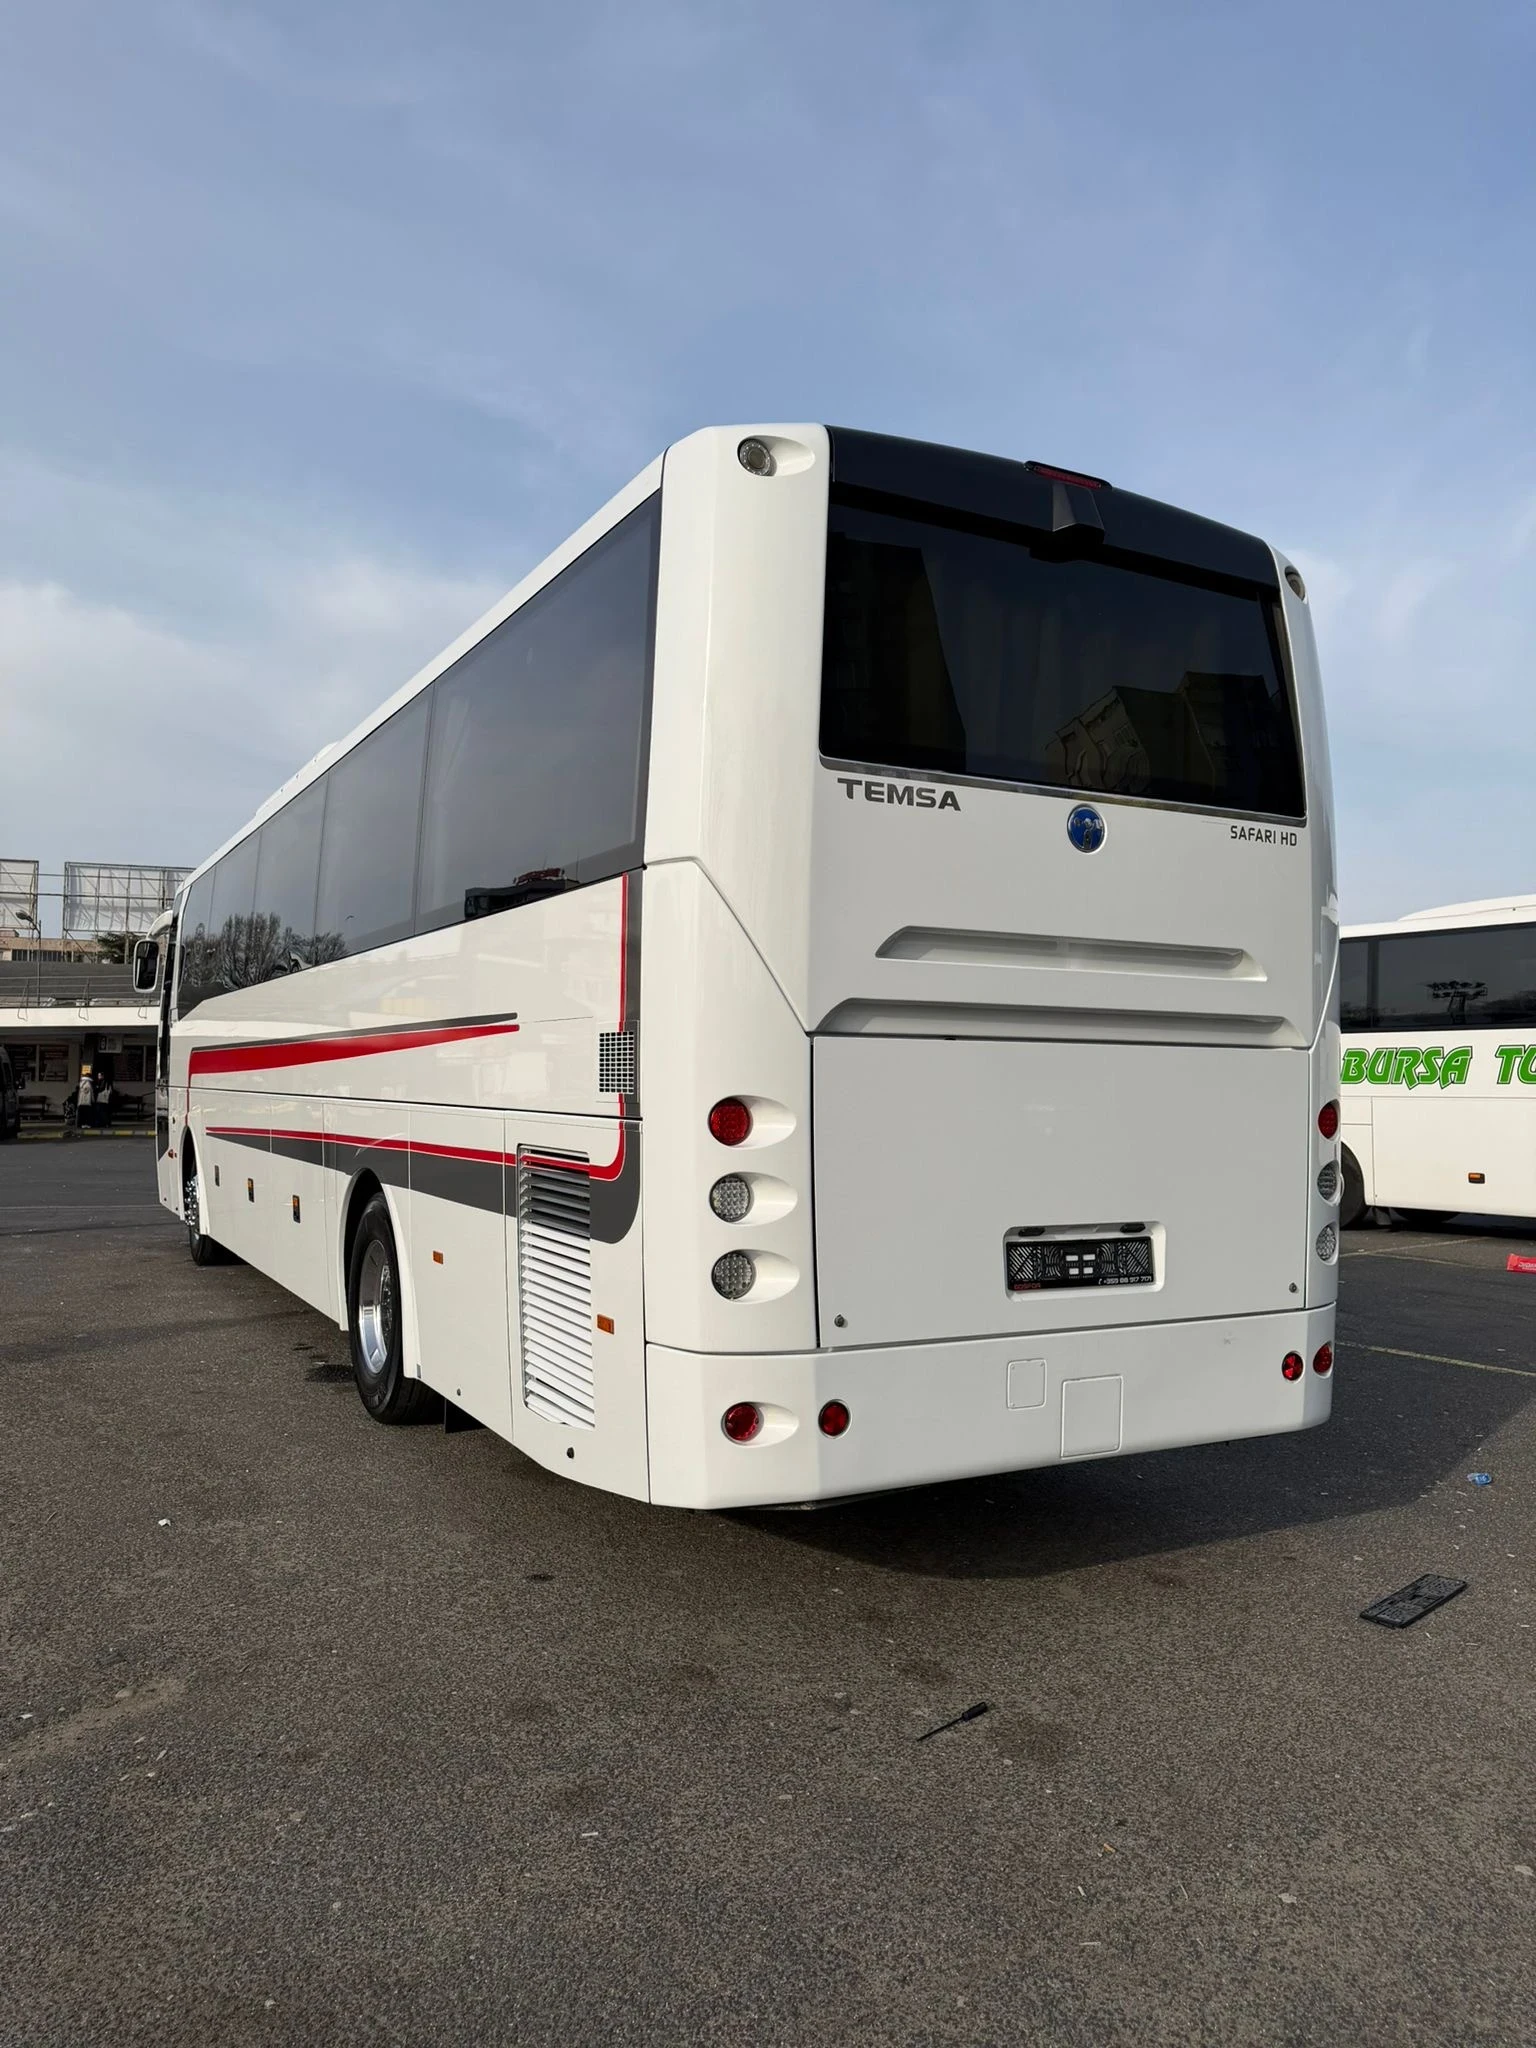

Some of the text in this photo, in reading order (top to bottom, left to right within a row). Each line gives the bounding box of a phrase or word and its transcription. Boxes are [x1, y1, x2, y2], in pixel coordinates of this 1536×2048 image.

[837, 777, 961, 812] TEMSA
[1230, 825, 1297, 847] SAFARI HD
[1340, 1045, 1473, 1090] BURSA
